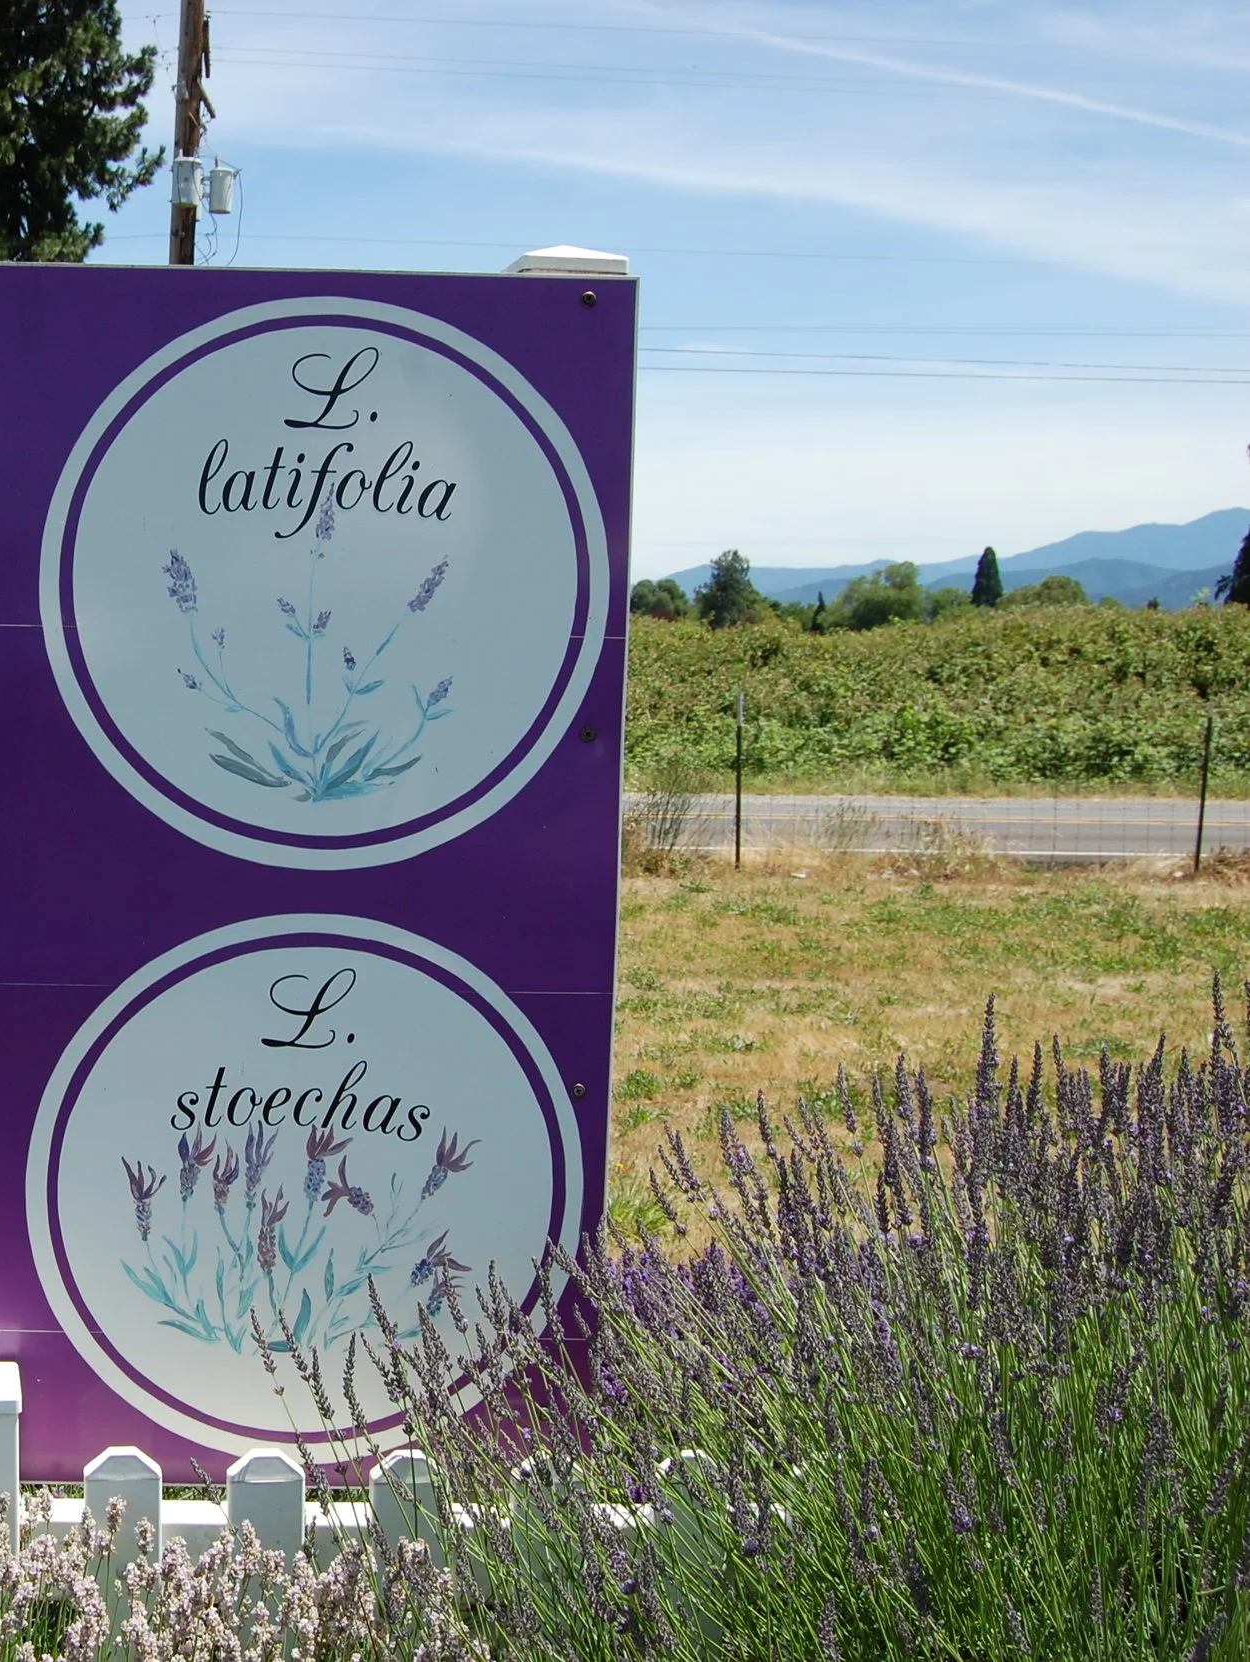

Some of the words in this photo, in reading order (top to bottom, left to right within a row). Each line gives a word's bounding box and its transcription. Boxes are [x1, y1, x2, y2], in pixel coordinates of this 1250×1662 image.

[284, 346, 379, 430] L.
[198, 438, 458, 539] latifolia
[260, 967, 357, 1049] L.
[170, 1060, 431, 1142] stoechas
